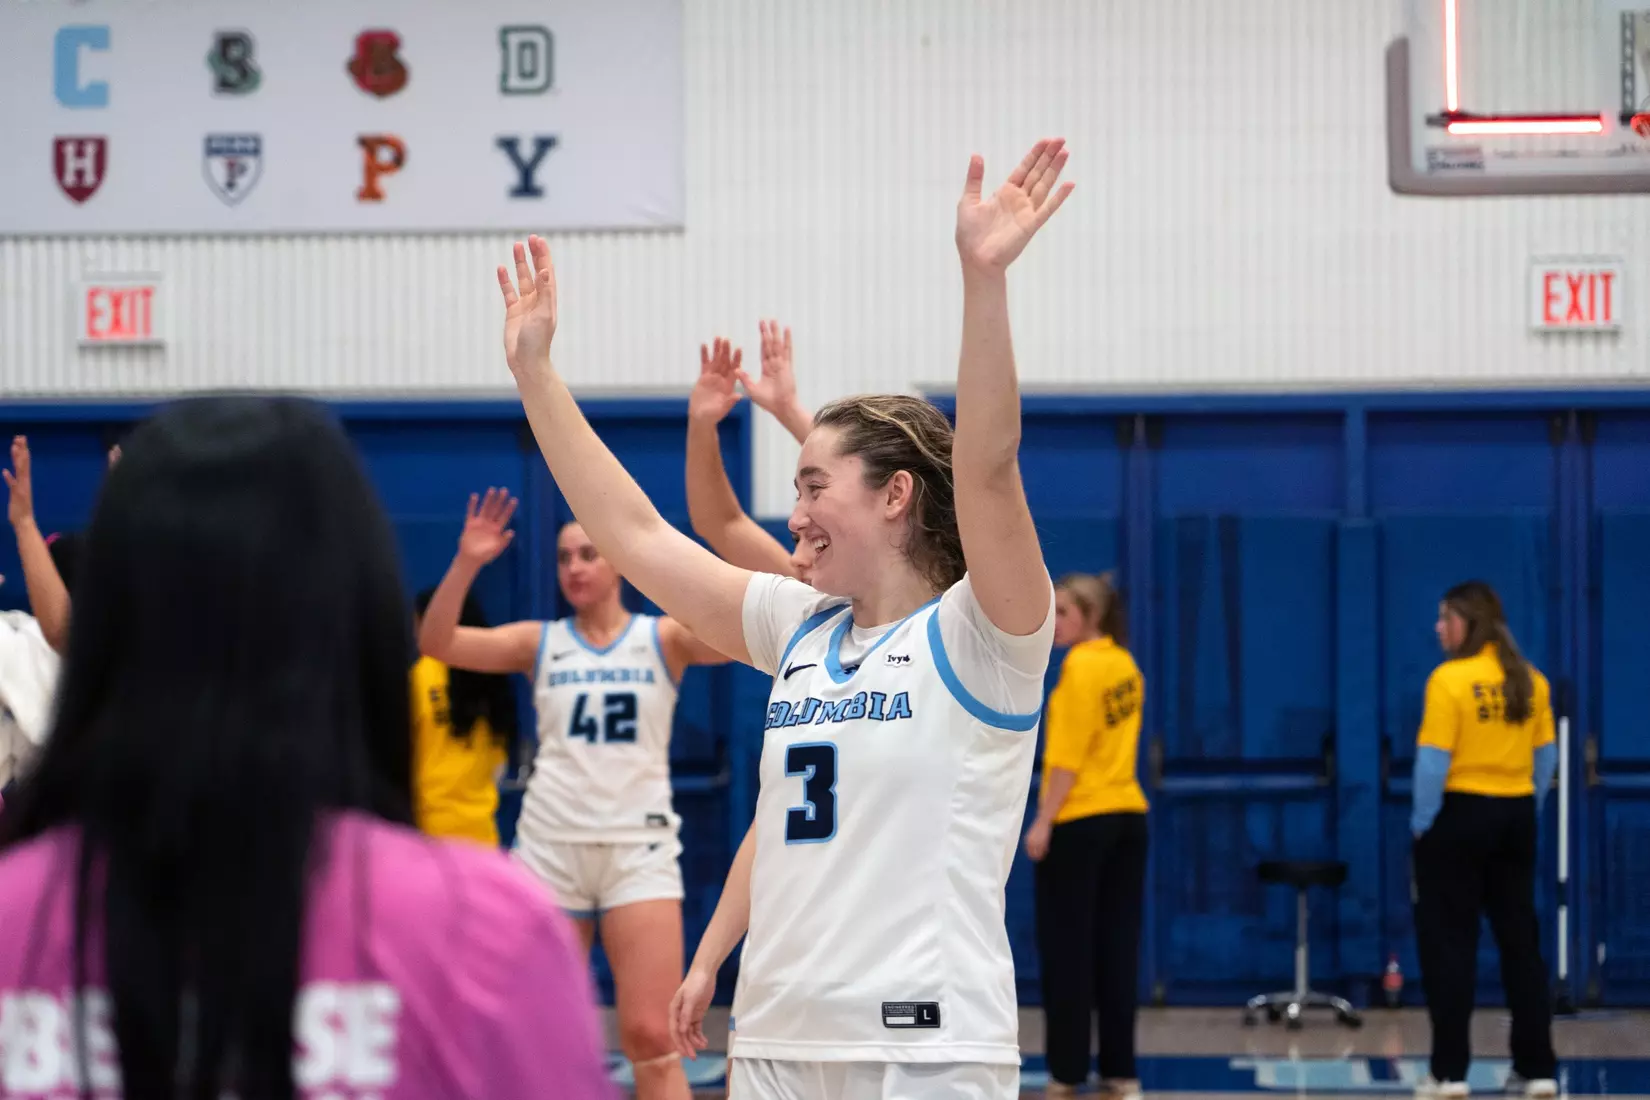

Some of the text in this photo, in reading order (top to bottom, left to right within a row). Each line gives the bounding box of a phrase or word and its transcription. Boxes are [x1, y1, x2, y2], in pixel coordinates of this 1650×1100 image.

[54, 25, 110, 107] C
[499, 25, 554, 95] D
[63, 141, 98, 188] H
[356, 133, 407, 202] P
[496, 136, 558, 199] Y
[86, 285, 155, 340] EXIT
[1542, 270, 1615, 325] EXIT
[547, 667, 656, 688] COLUMBIA
[567, 690, 638, 744] 42
[765, 691, 913, 731] COLUMBIA
[784, 741, 839, 845] 3
[923, 1009, 932, 1020] L
